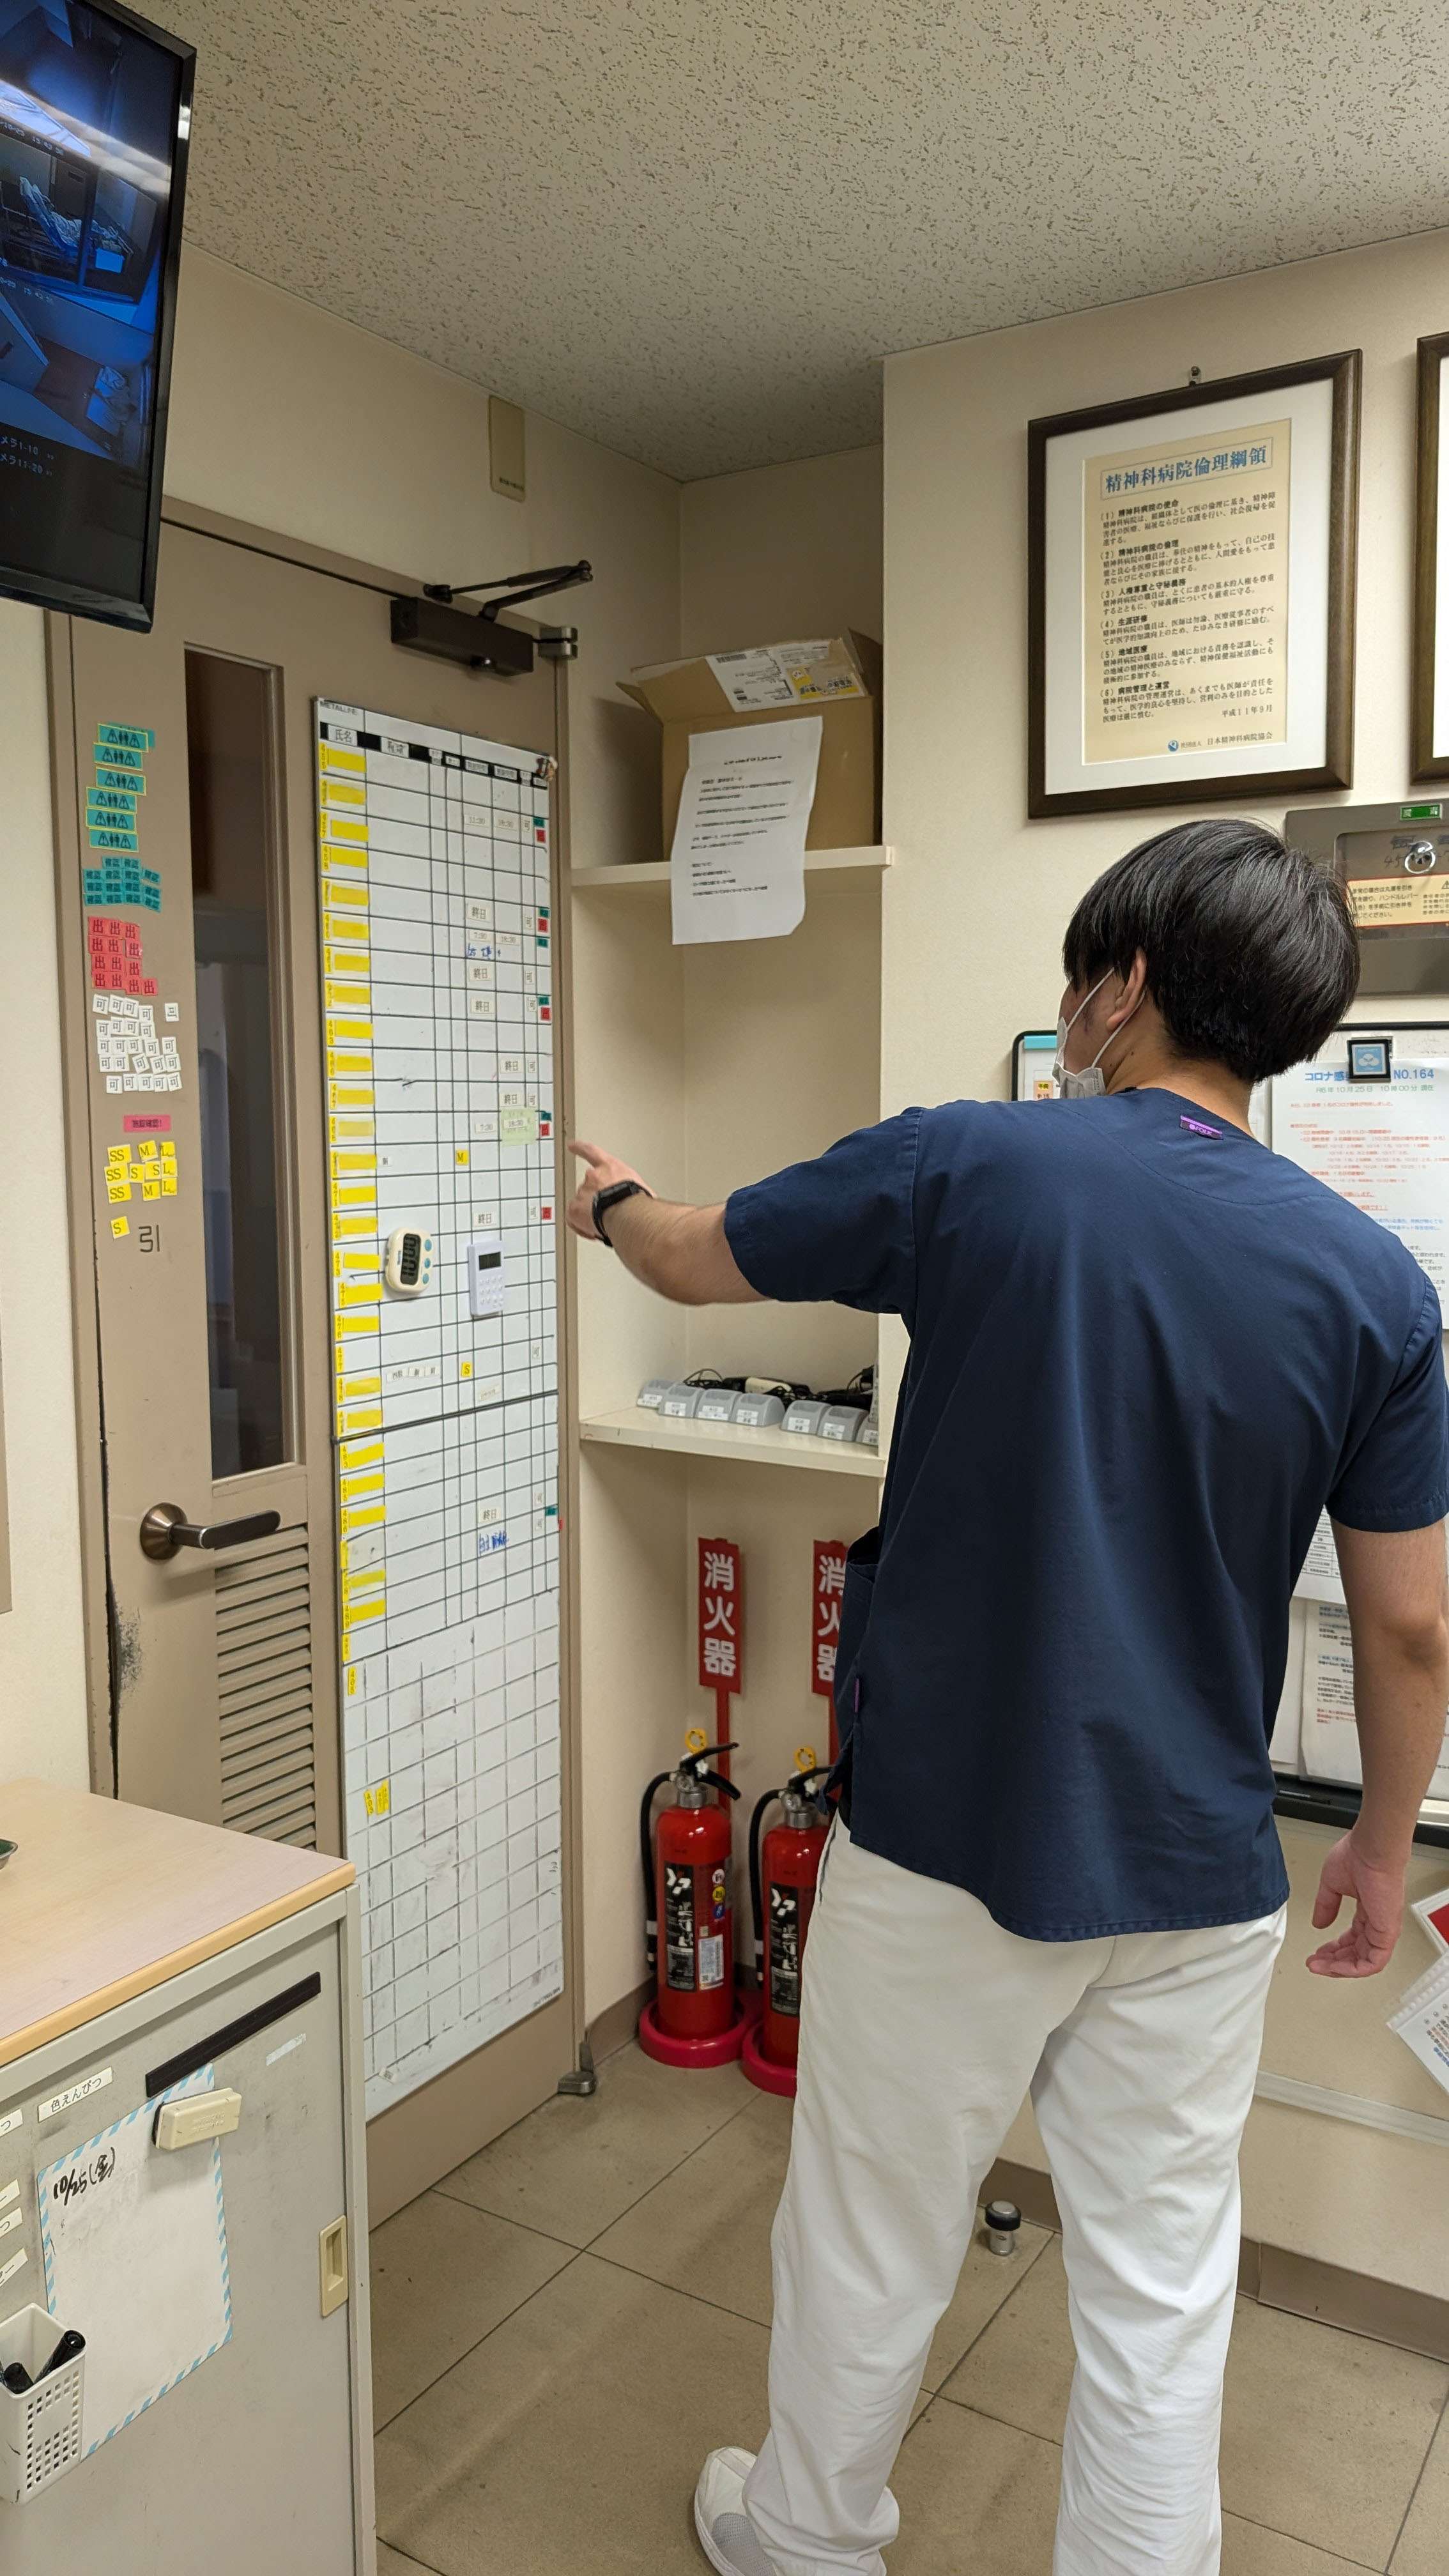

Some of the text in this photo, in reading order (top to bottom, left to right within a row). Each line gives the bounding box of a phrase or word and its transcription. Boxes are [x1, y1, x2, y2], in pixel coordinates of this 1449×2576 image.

[1106, 445, 1267, 493] 精神科病院倫理綱領
[1118, 499, 1179, 517] 精神科病院の使命
[1118, 539, 1179, 556] 精神科病院の倫理
[335, 729, 353, 743] 氏名
[1207, 732, 1273, 746] 日本精神科病院協会
[93, 919, 103, 933] 出
[111, 922, 120, 935] 出
[126, 925, 135, 939] 出
[93, 937, 103, 952] 出
[109, 939, 119, 953] 出
[130, 942, 139, 956] 出
[95, 956, 105, 970] 出
[112, 956, 121, 970] 出
[130, 962, 139, 976] 出
[96, 974, 105, 988] 出
[112, 974, 122, 987] 出
[129, 979, 139, 993] 出
[144, 981, 154, 994] 出
[96, 998, 107, 1010] 可
[113, 1000, 123, 1013] 可
[126, 1002, 136, 1015] 可
[142, 1008, 151, 1021] 可
[167, 1006, 178, 1018] 可
[99, 1022, 109, 1036] 可
[113, 1020, 122, 1032] 可
[128, 1021, 137, 1034] 可
[142, 1025, 152, 1038] 可
[100, 1039, 110, 1053] 可
[116, 1039, 126, 1053] 可
[130, 1038, 139, 1052] 可
[148, 1041, 157, 1054] 可
[165, 1039, 174, 1053] 可
[102, 1056, 111, 1070] 可
[116, 1056, 125, 1070] 可
[135, 1057, 146, 1071] 可
[154, 1058, 164, 1071] 可
[169, 1056, 178, 1070] 可
[170, 1075, 179, 1088] 可
[1305, 1068, 1434, 1081] コロナ感 NO.164
[109, 1077, 119, 1091] 可
[125, 1076, 134, 1089] 可
[142, 1076, 151, 1089] 可
[156, 1077, 165, 1090] 可
[110, 1150, 125, 1162] SS
[140, 1146, 150, 1156] M
[106, 1169, 121, 1181] SS
[131, 1168, 138, 1179] S
[153, 1165, 160, 1176] S
[110, 1187, 125, 1200] SS
[144, 1185, 153, 1197] M
[113, 1222, 121, 1234] S
[464, 1363, 470, 1374] S
[704, 1551, 737, 1677] 消火器
[50, 2078, 102, 2113] 色えんぴつ
[54, 2147, 116, 2206] 10/25(金)
